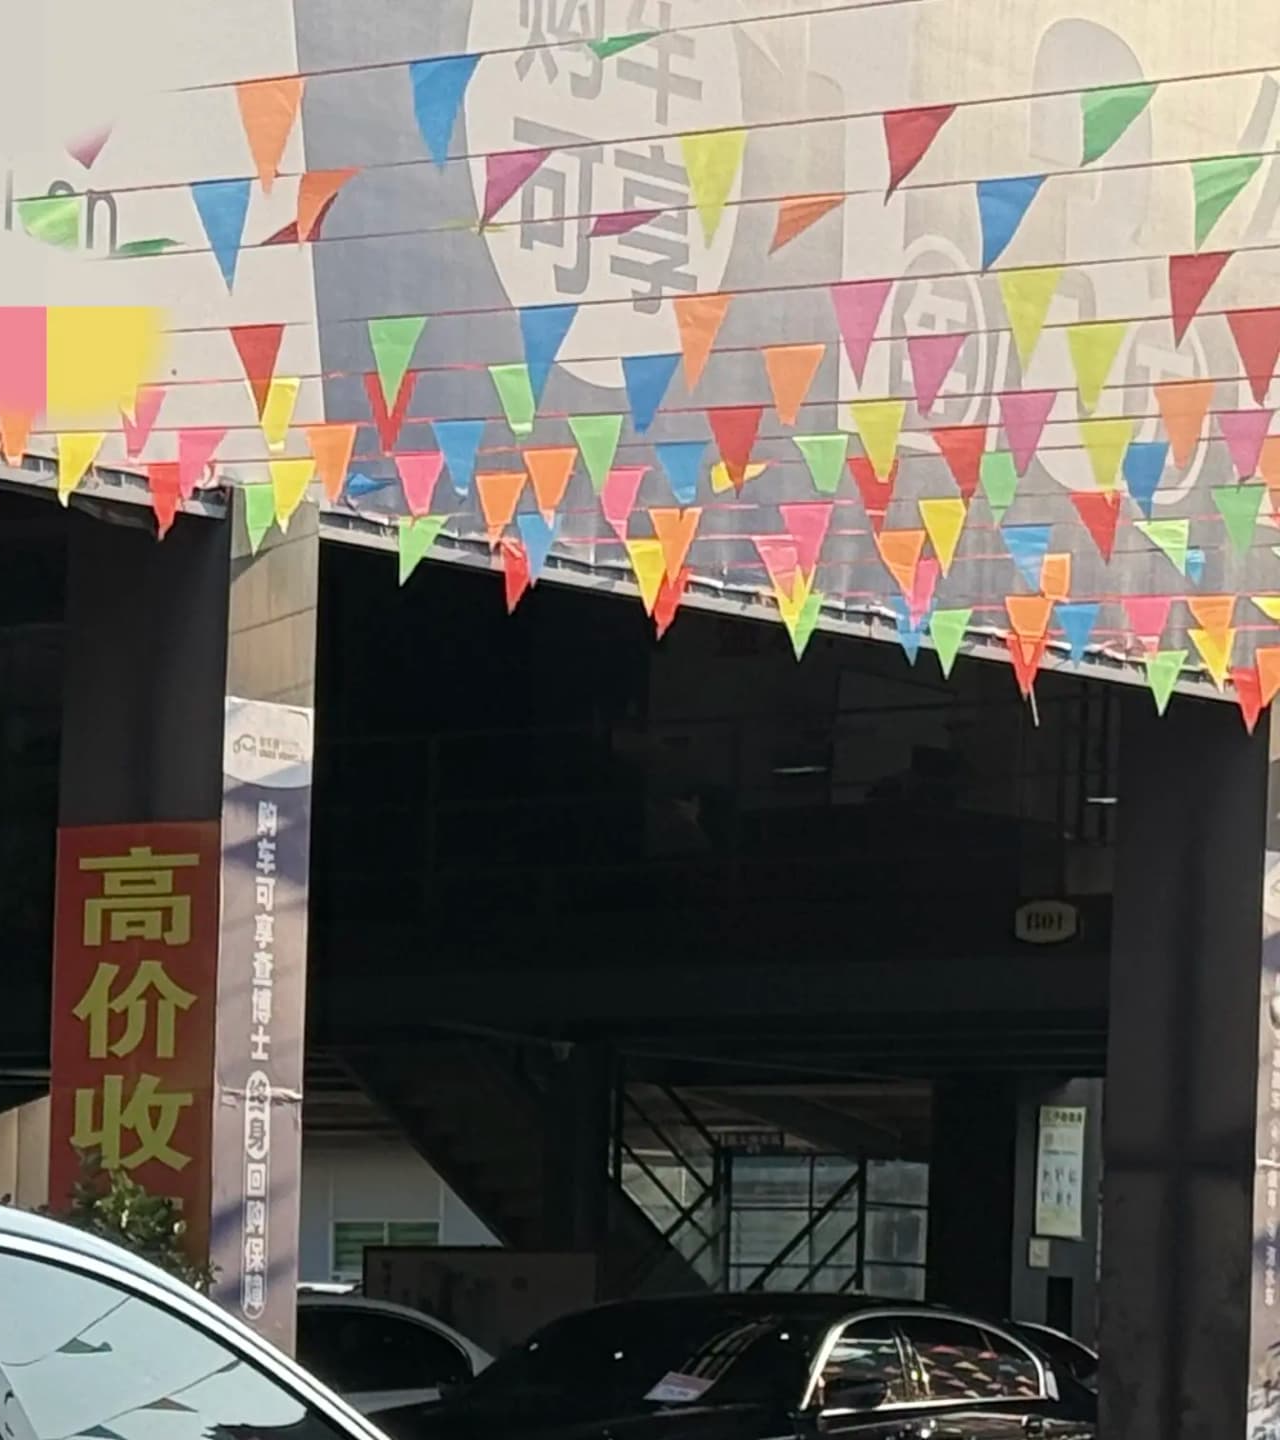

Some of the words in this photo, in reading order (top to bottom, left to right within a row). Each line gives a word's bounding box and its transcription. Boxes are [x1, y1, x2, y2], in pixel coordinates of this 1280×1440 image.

[513, 116, 697, 314] 可享
[69, 846, 201, 1209] 高价收
[250, 800, 279, 1062] 购车可享查博士
